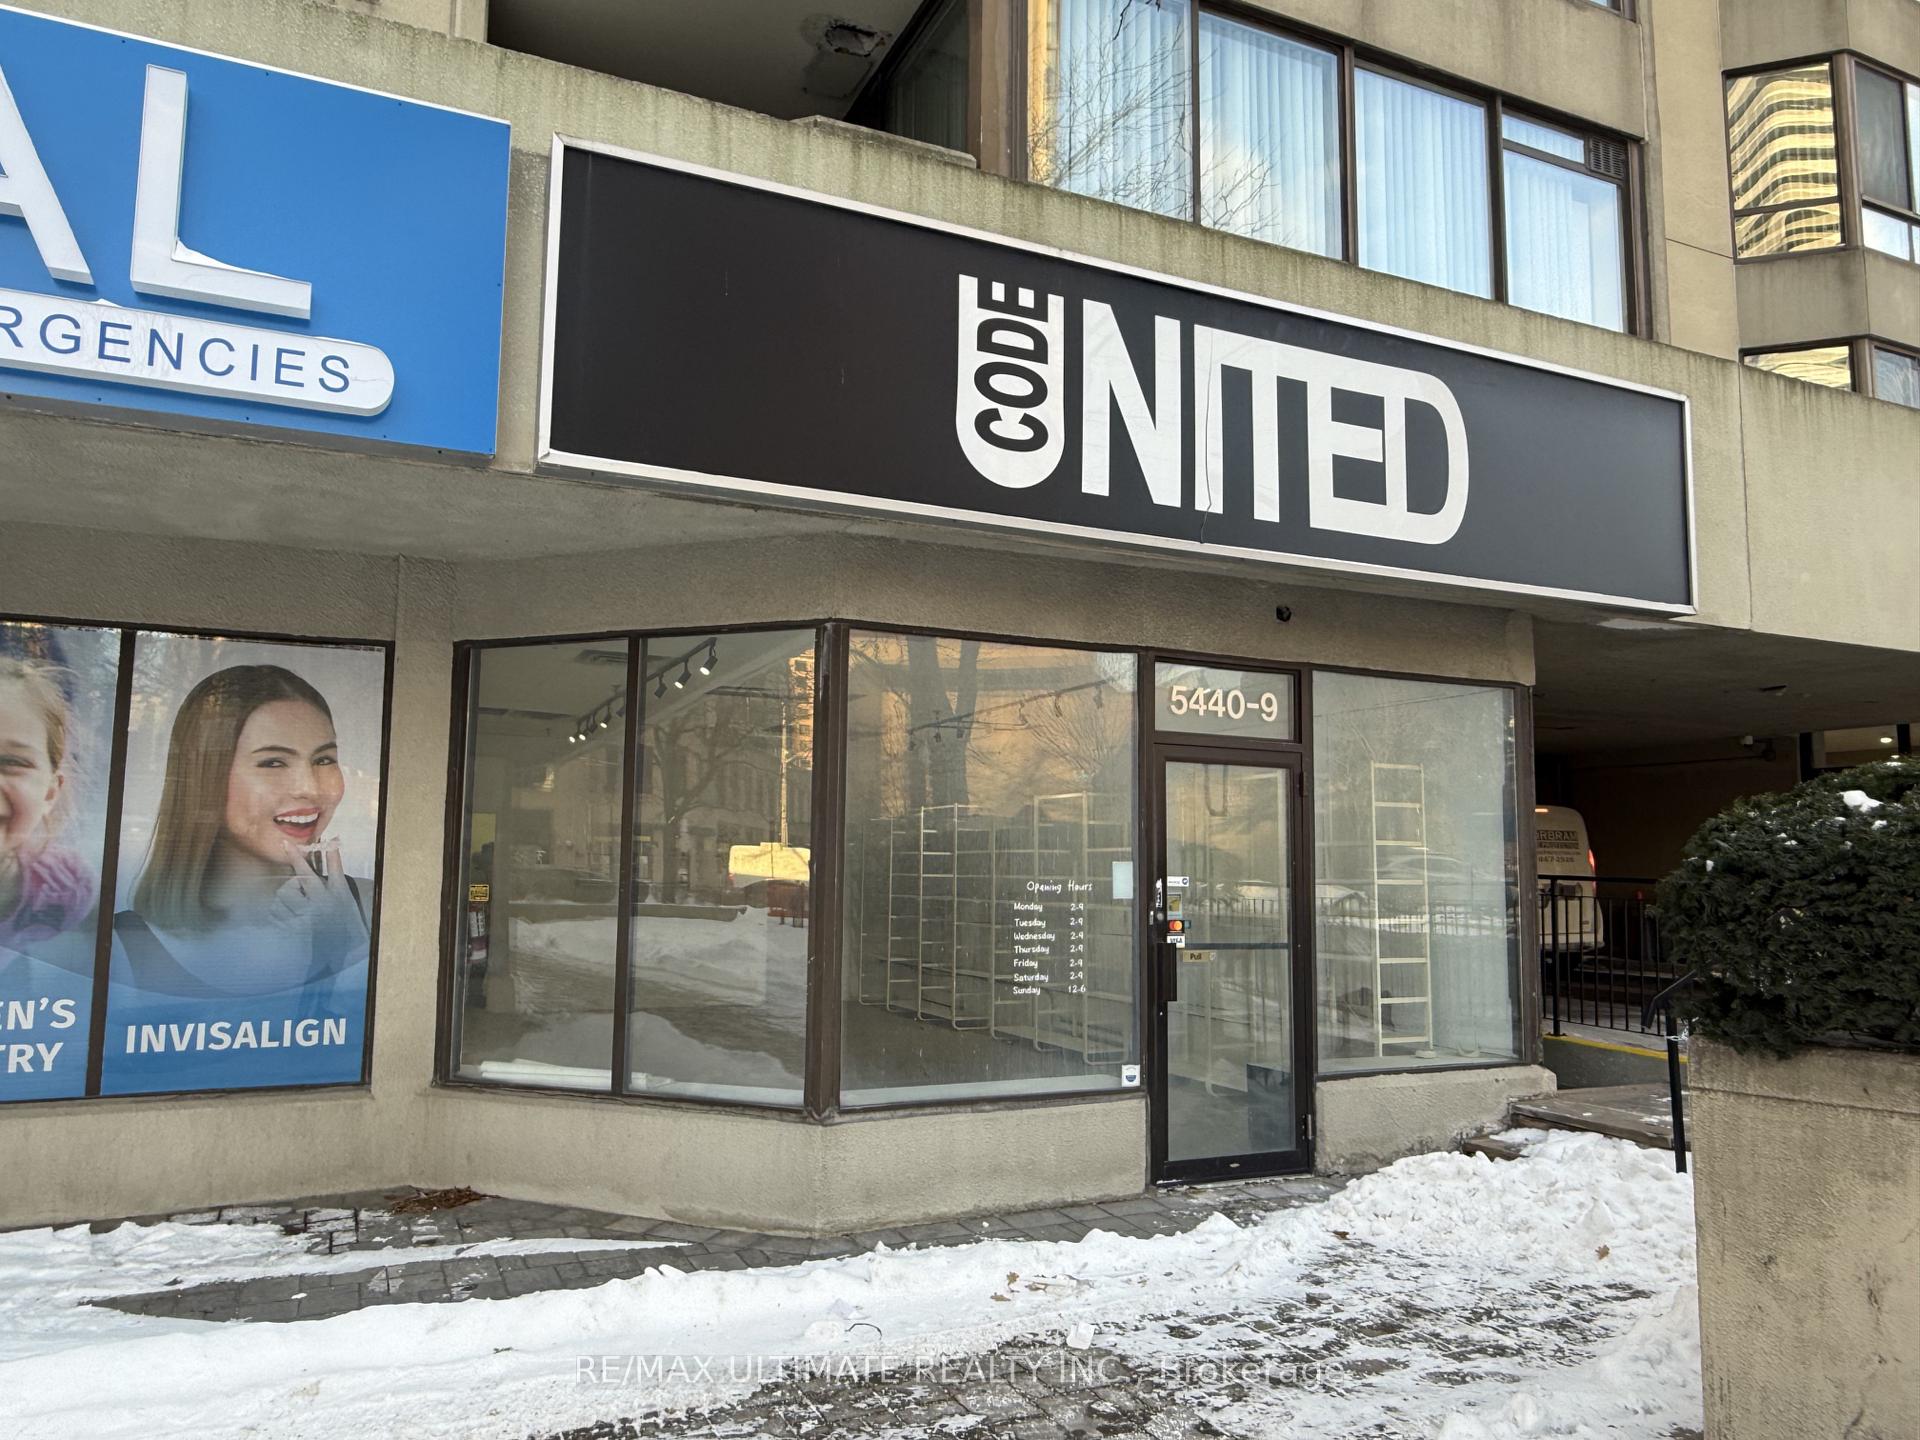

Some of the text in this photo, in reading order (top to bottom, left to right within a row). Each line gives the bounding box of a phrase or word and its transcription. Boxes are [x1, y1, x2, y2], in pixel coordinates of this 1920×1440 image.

[974, 277, 1049, 452] CODE
[956, 274, 1469, 545] UNITED
[1169, 685, 1278, 722] 5440-9
[1026, 880, 1093, 894] Opening Hours
[1013, 902, 1084, 912] Monday 2-9
[1014, 918, 1083, 928] Tuesday 2-9
[1013, 931, 1084, 942] Wednesday 2-9
[1013, 944, 1083, 954] Thursday 2-9
[1013, 958, 1083, 969] Friday 2-9
[1013, 971, 1083, 983] Saturday 2-9
[1012, 984, 1086, 996] Sunday 12-6
[0, 997, 76, 1030] N'S
[126, 1017, 347, 1053] INVISALIGN
